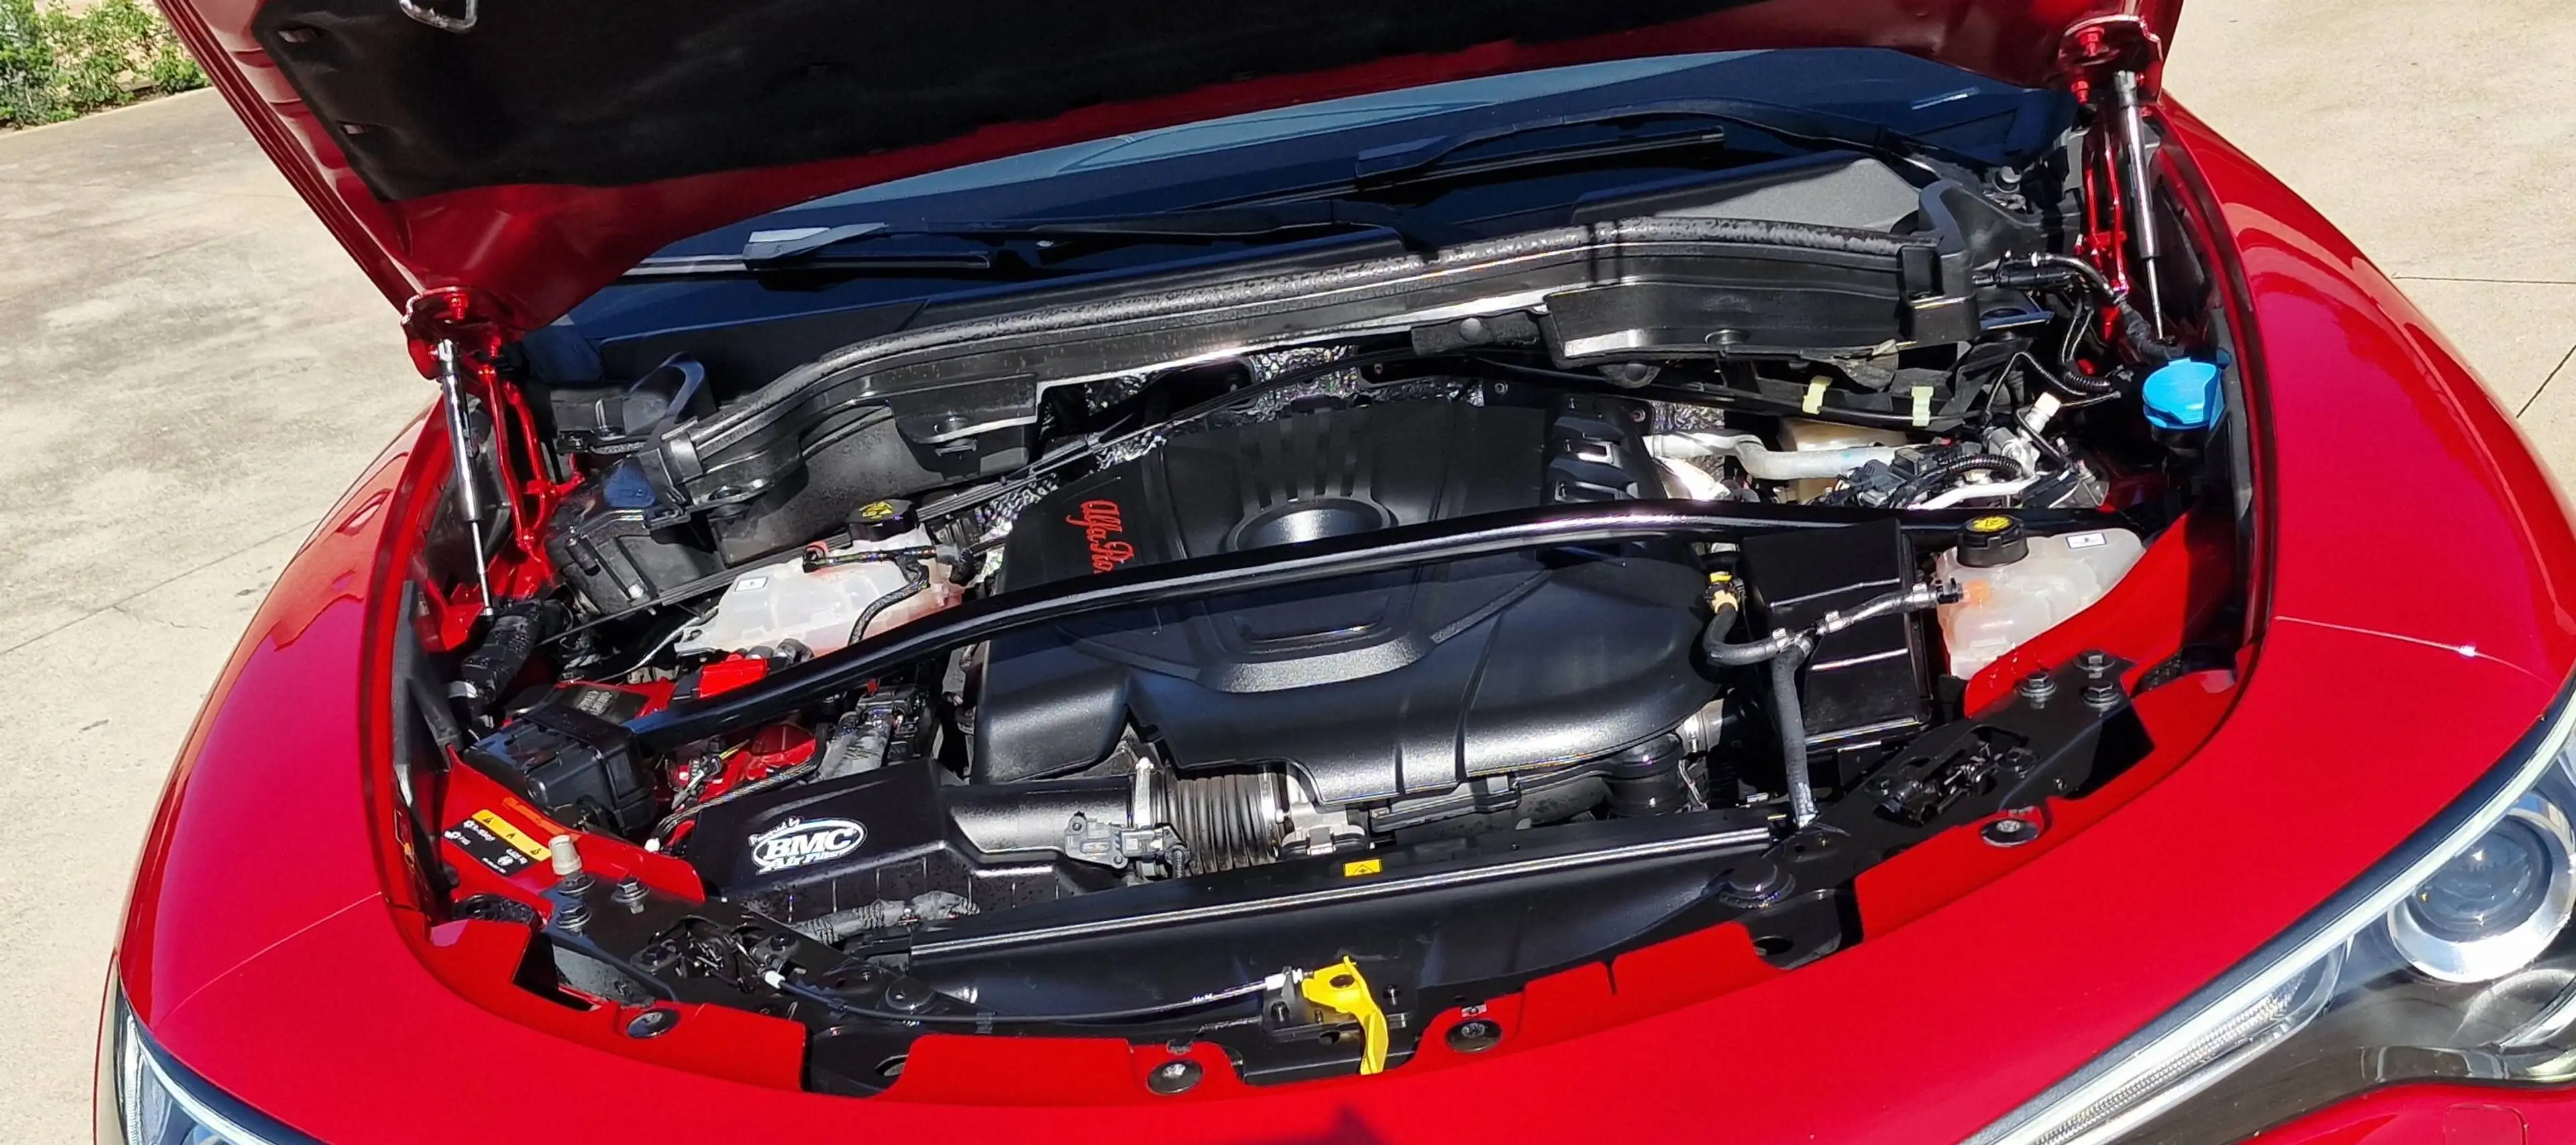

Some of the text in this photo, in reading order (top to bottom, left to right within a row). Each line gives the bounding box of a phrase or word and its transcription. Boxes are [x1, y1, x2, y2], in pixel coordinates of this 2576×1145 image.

[1066, 500, 1122, 543] Alfa
[763, 828, 854, 860] BMC
[757, 856, 802, 874] Air
